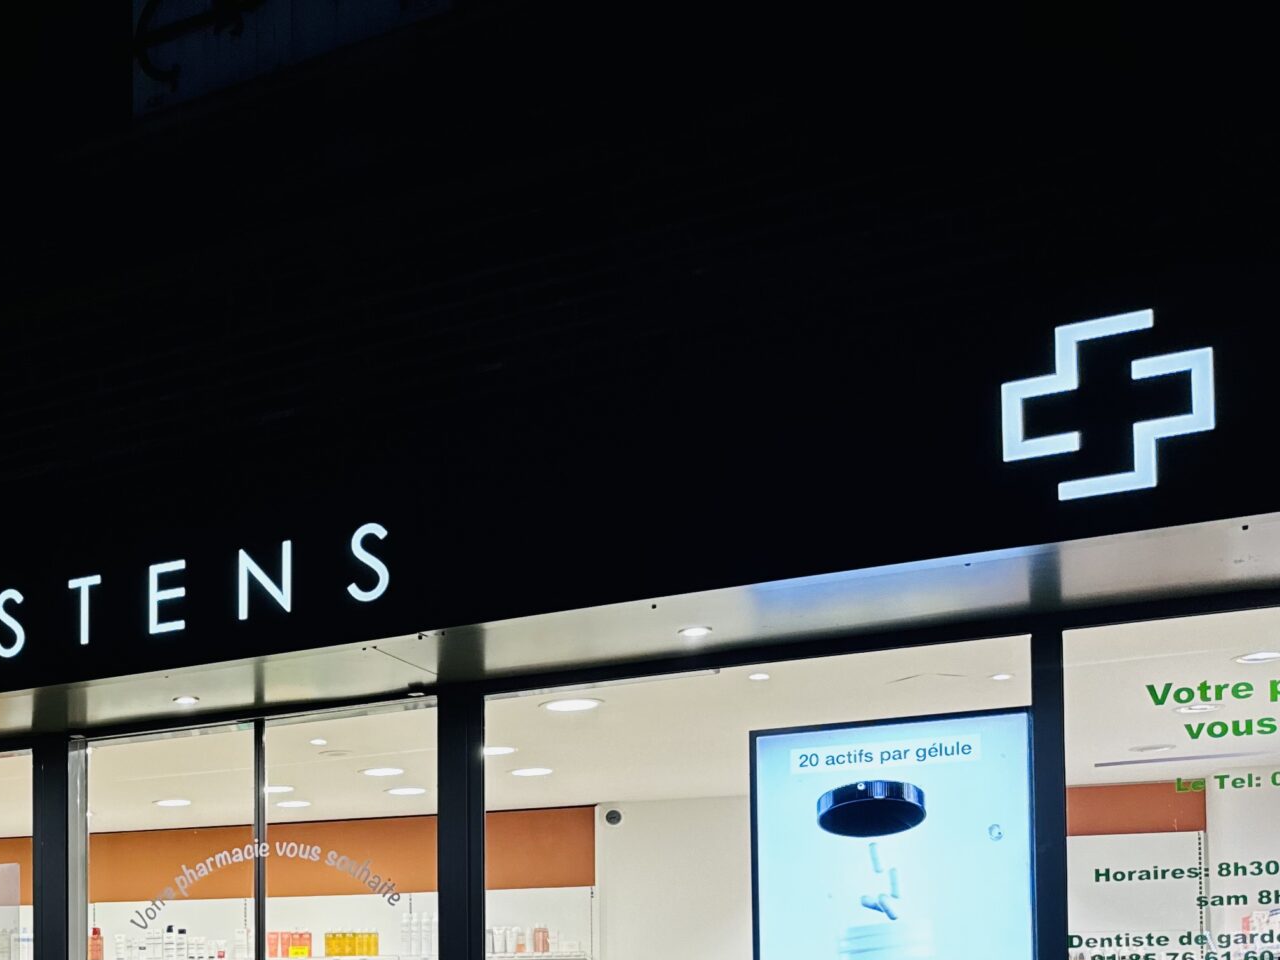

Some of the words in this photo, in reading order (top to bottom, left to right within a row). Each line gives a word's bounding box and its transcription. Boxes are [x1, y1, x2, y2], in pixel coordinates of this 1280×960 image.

[1145, 680, 1254, 705] Votre
[1184, 717, 1277, 739] vous
[799, 753, 819, 768] 20
[825, 749, 874, 766] actifs
[880, 748, 910, 764] par
[915, 741, 972, 762] gélule
[1175, 778, 1205, 792] Le
[1214, 773, 1261, 789] Tel:
[130, 884, 175, 930] Votre
[174, 839, 270, 897] pharmacie
[276, 841, 321, 862] vous
[324, 850, 401, 907] souhaite
[1196, 893, 1248, 907] sam
[1067, 932, 1169, 949] Dentiste
[1178, 931, 1208, 946] de
[1217, 929, 1280, 949] gard
